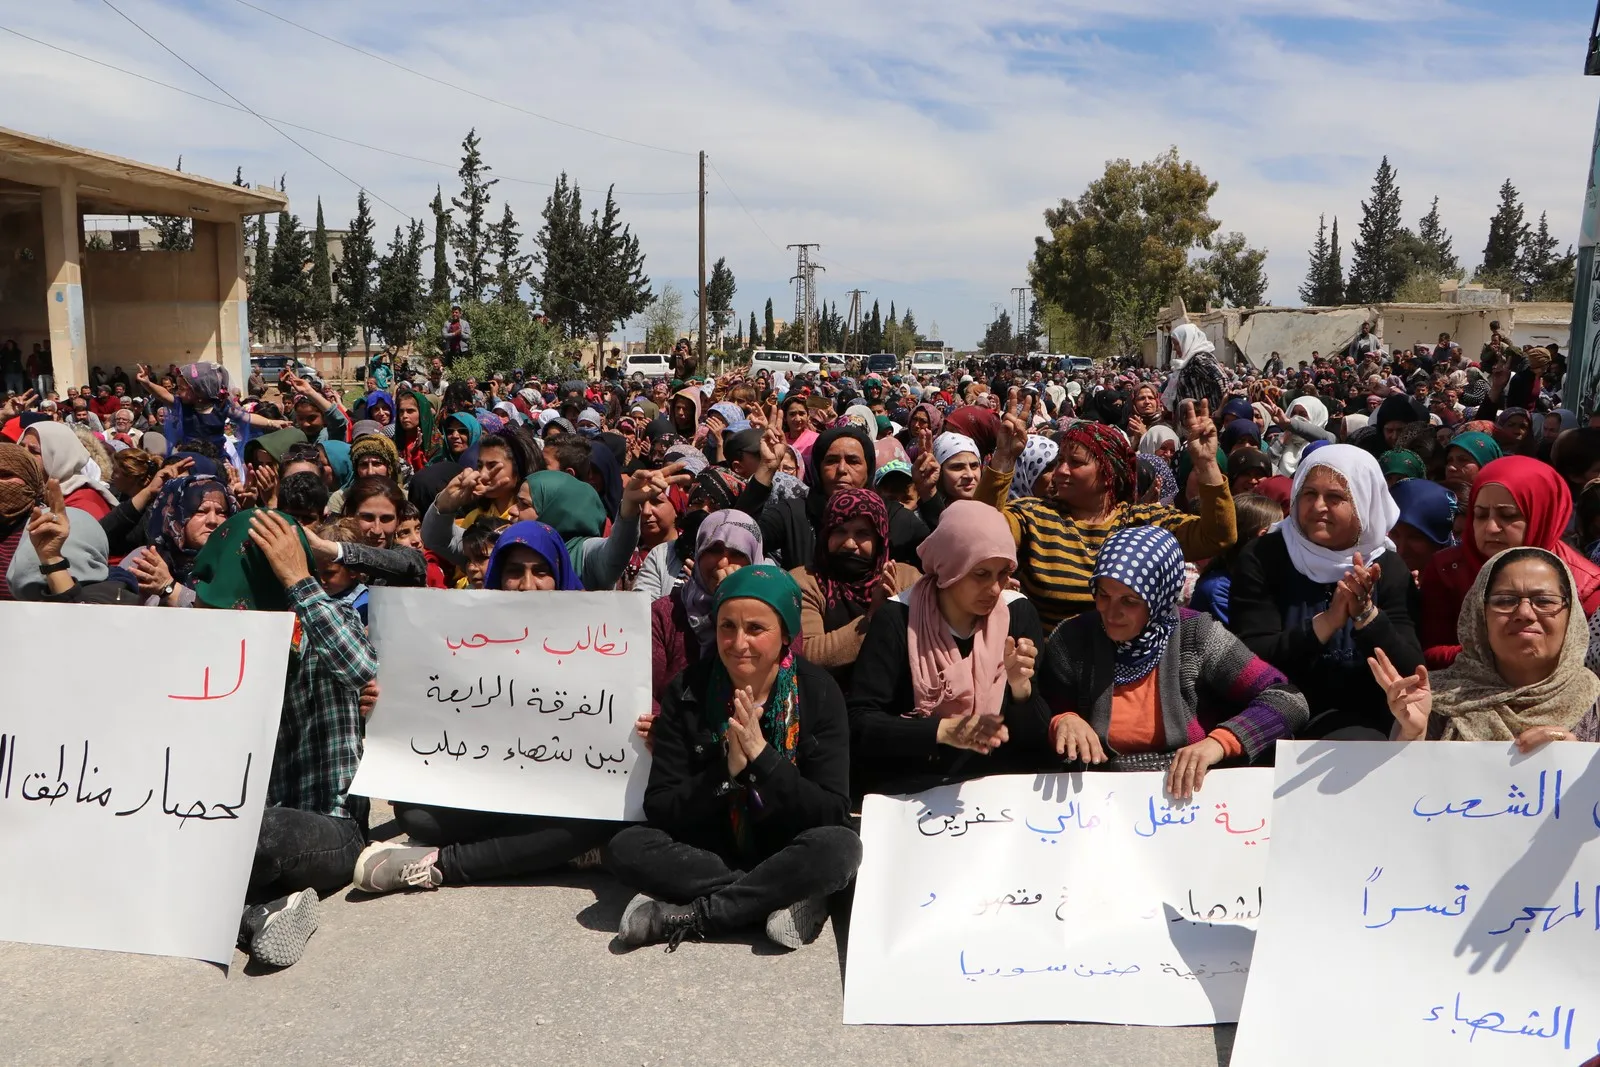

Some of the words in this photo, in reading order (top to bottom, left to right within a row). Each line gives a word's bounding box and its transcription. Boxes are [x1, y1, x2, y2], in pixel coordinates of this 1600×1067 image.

[543, 622, 628, 666] نطالب
[168, 638, 246, 700] لا
[427, 674, 514, 713] الرابعة
[527, 688, 614, 724] الفرقة
[410, 730, 467, 766] حلب
[473, 745, 489, 759] و
[503, 736, 573, 769] شهباء
[585, 745, 628, 775] بين
[22, 739, 112, 806] مناطق
[115, 746, 252, 830] لحصار
[1413, 769, 1563, 823] الشعب
[918, 807, 1014, 836] عفرين
[1134, 795, 1200, 837] تنقل
[960, 950, 1067, 982] سوريا
[1423, 992, 1576, 1050] الشهباء
